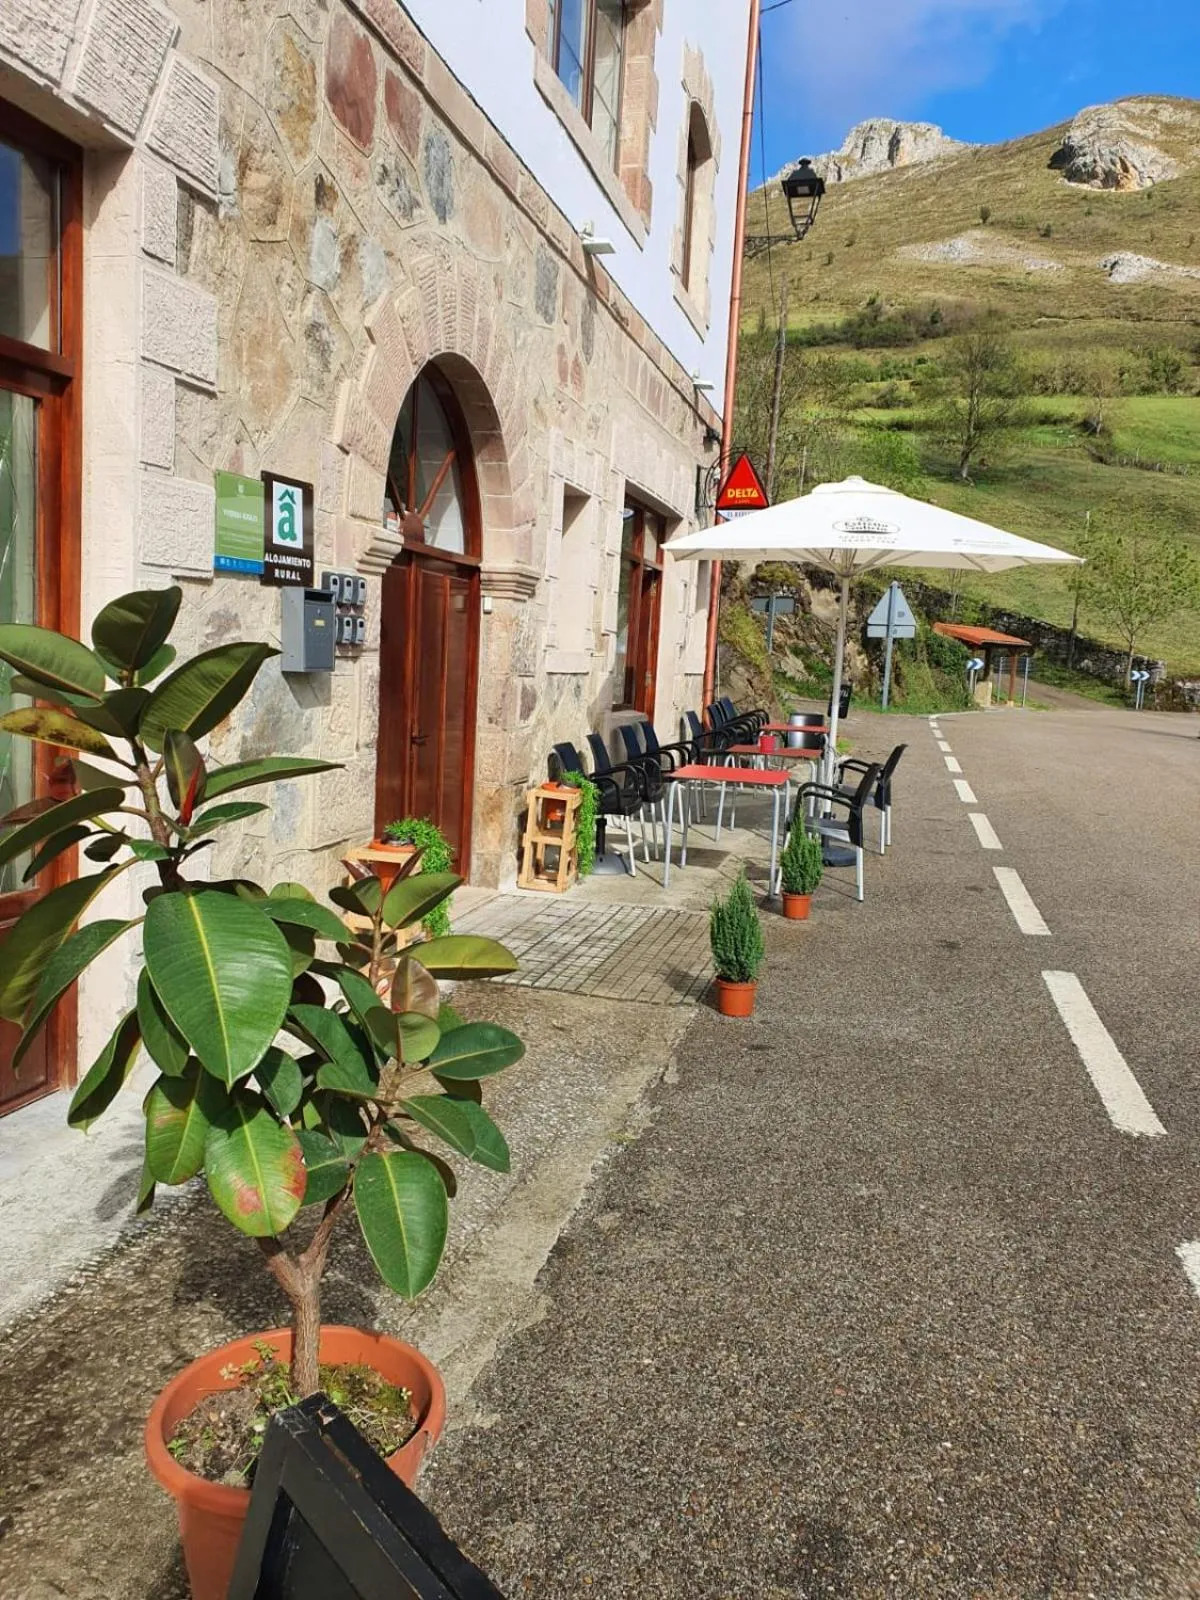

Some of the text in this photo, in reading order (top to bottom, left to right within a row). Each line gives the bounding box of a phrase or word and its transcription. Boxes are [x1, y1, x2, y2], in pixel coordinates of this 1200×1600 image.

[727, 487, 759, 498] DELTA
[264, 552, 311, 568] ALOJAMIENTO
[274, 568, 301, 580] RURAL
